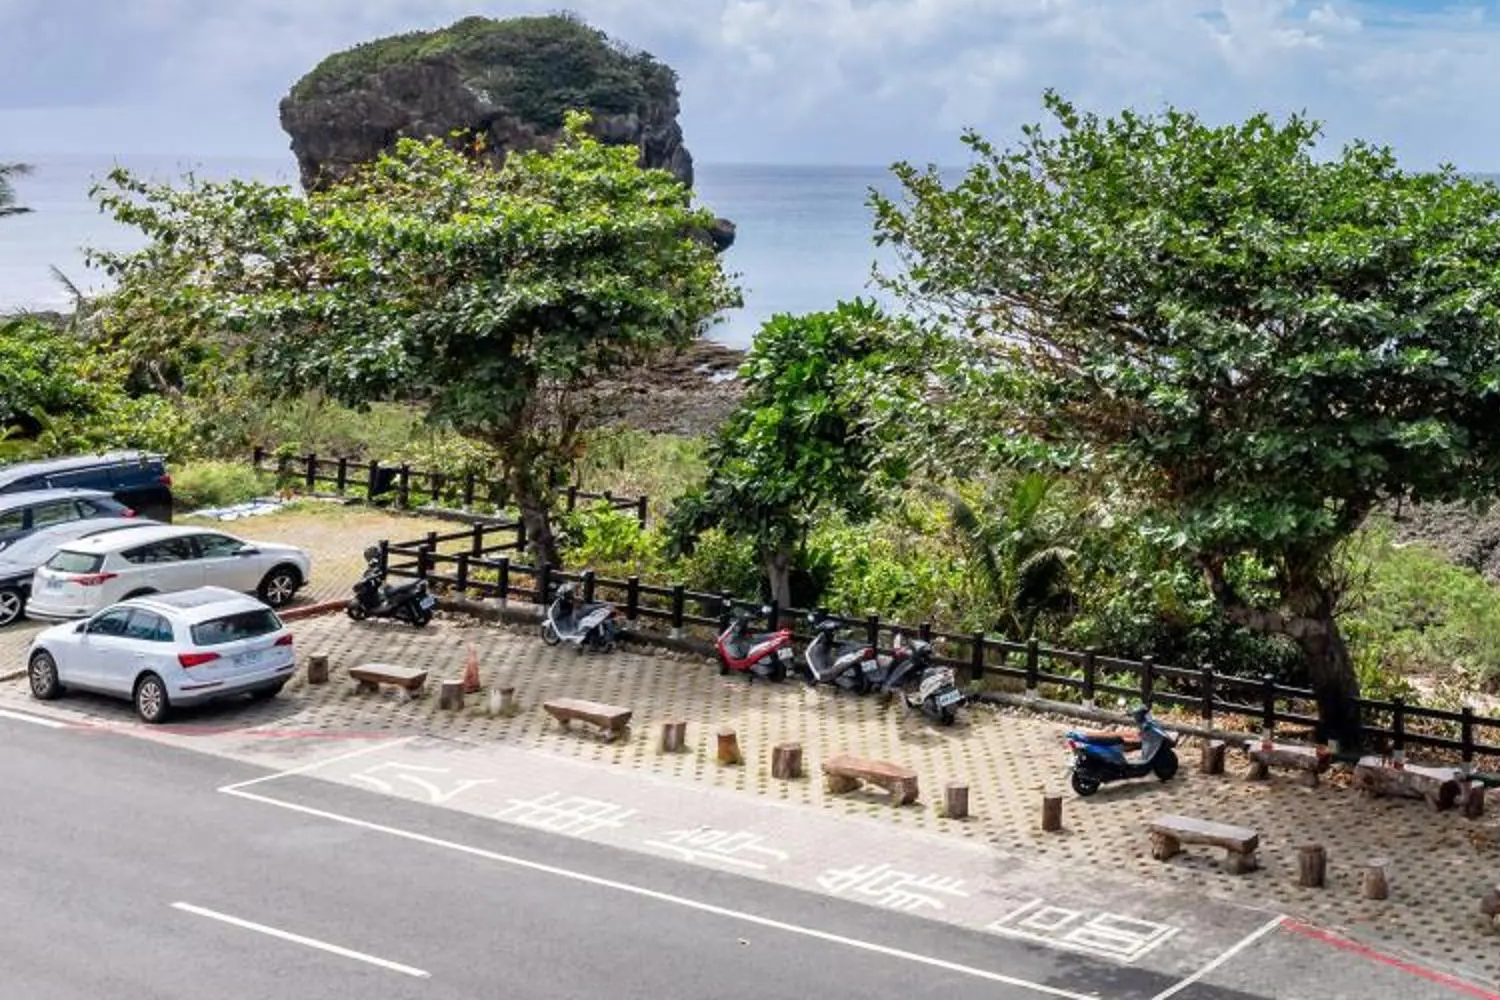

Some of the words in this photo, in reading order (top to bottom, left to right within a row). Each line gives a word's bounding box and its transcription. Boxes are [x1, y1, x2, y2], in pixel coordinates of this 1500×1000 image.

[349, 761, 1182, 962] 公車停靠區
